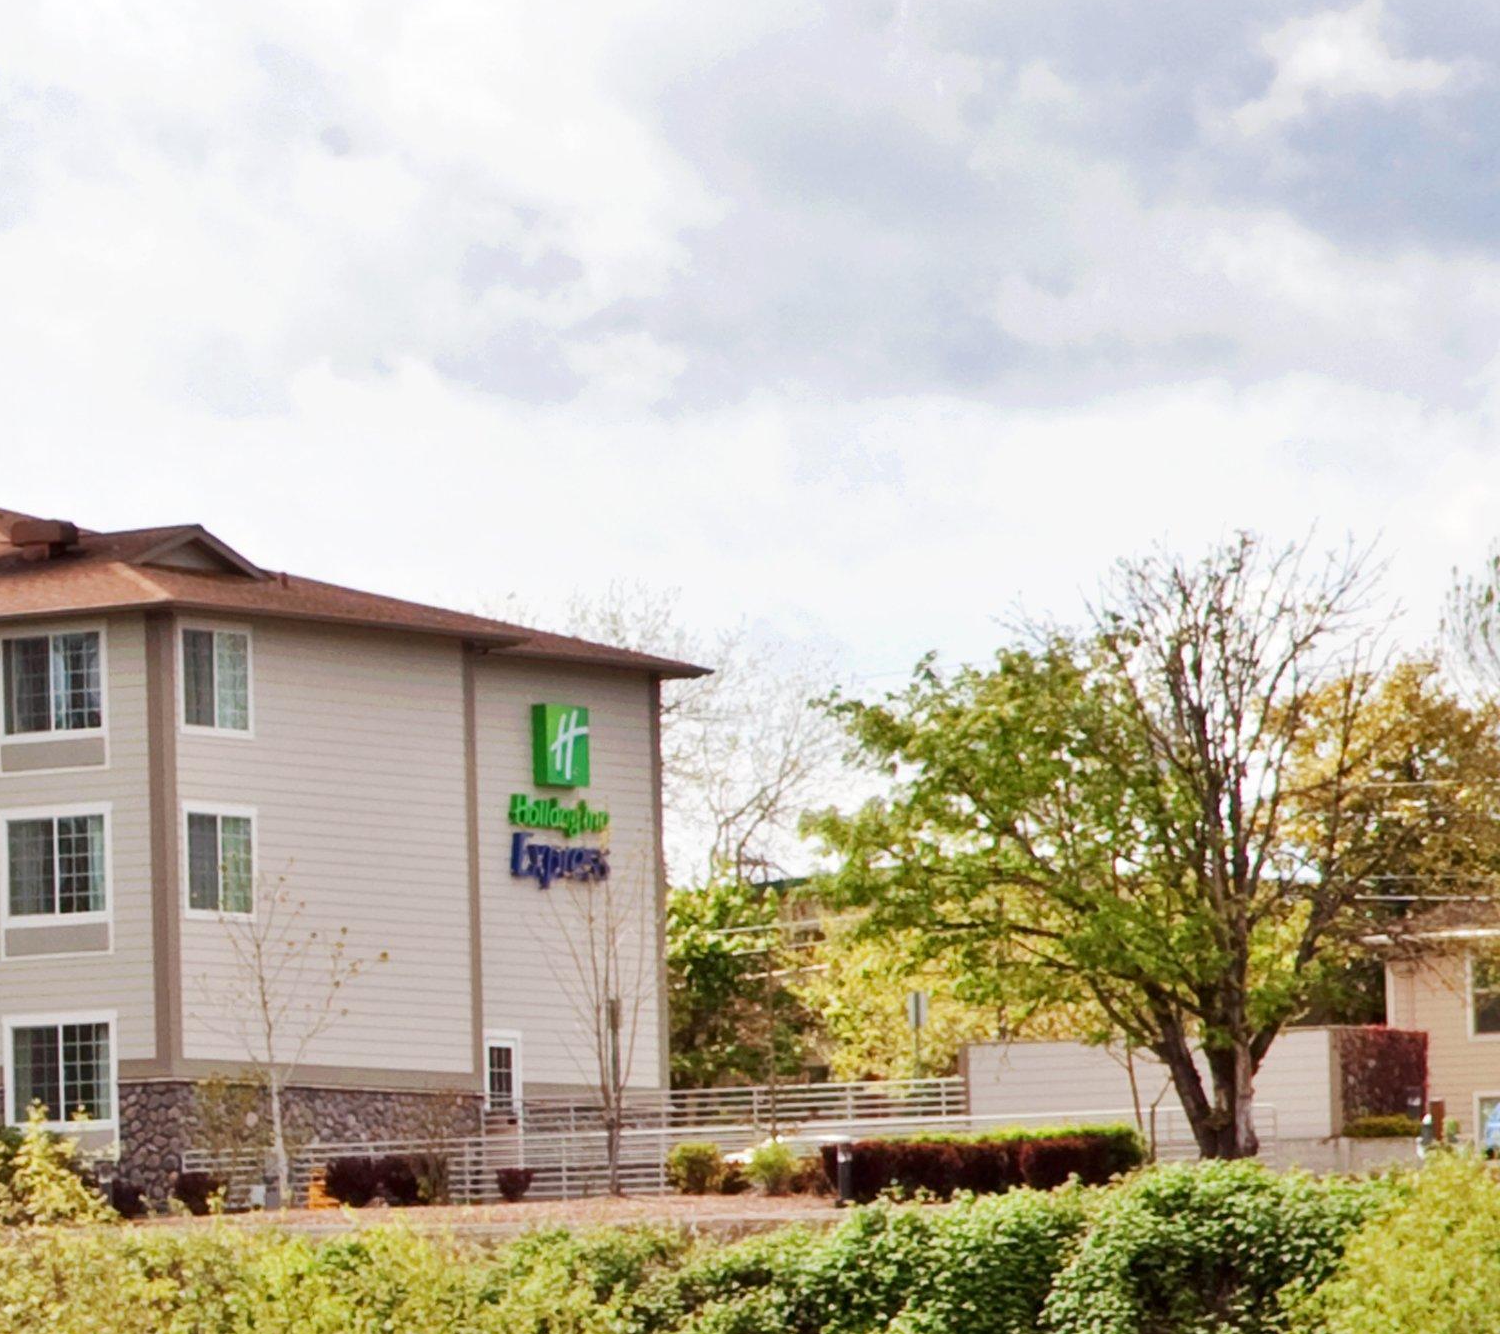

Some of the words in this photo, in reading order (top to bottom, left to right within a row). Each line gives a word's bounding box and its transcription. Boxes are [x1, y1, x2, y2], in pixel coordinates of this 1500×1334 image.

[551, 709, 590, 781] H
[509, 794, 580, 838] Holiday
[579, 800, 609, 833] Inn
[511, 832, 610, 889] Express
